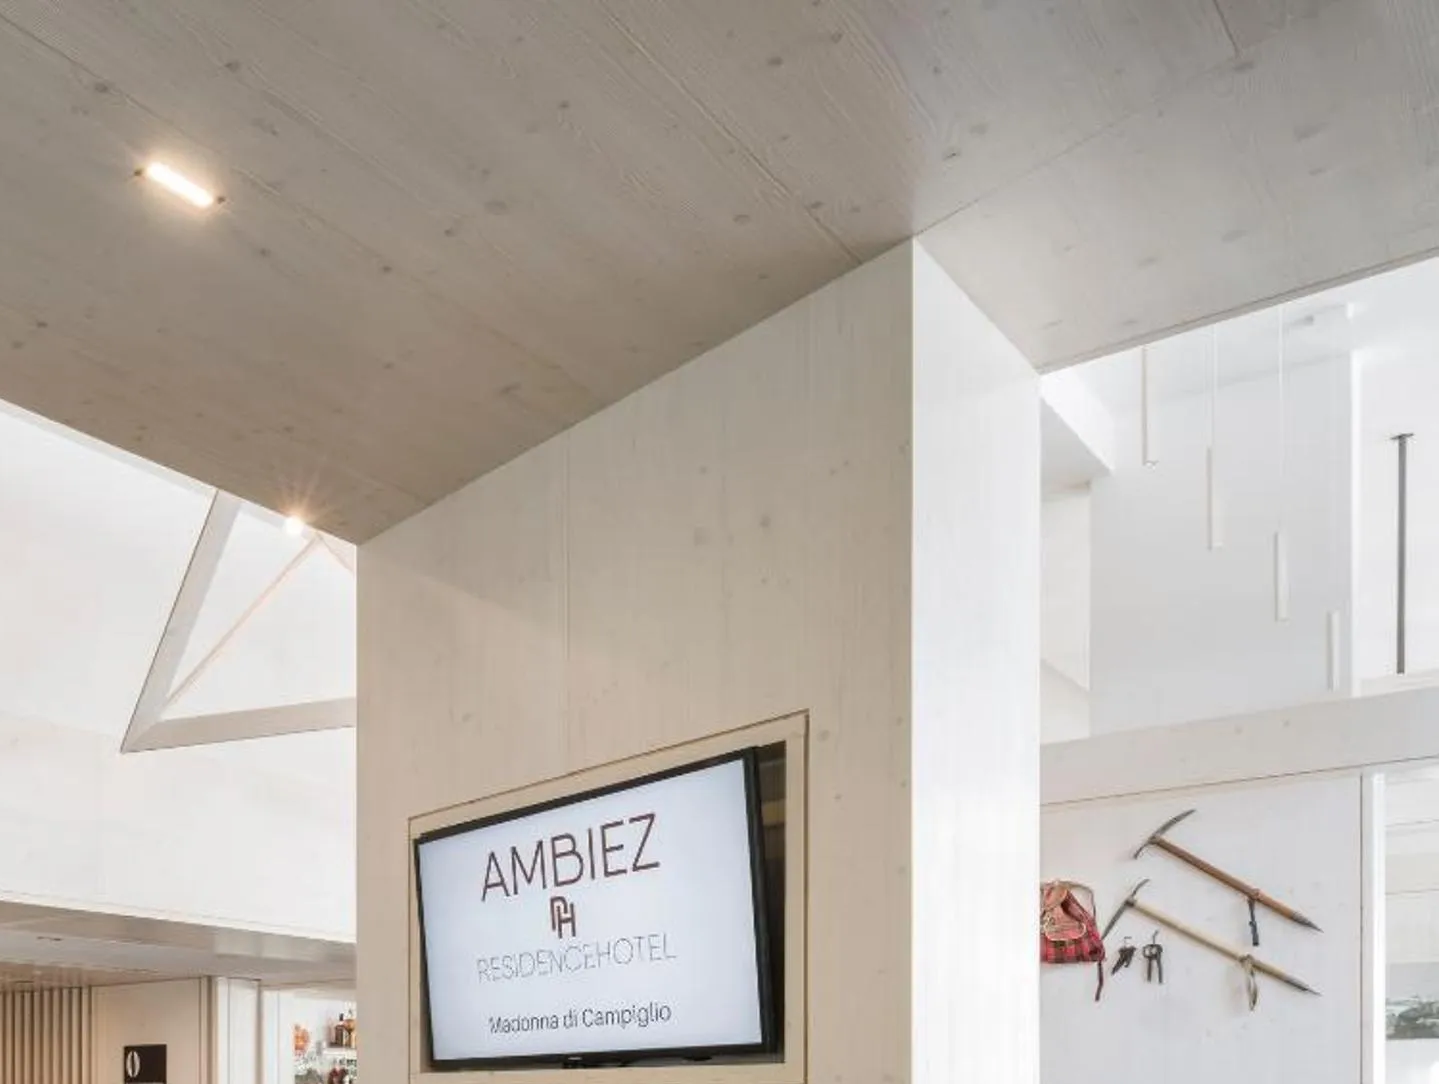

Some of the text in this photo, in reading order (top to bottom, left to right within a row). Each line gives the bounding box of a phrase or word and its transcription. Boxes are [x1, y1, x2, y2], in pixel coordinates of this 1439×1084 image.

[481, 813, 660, 902] AMBIEZ
[477, 932, 678, 984] RESIDENCEHOTEL
[489, 1002, 672, 1034] Madonna di Campiglio
